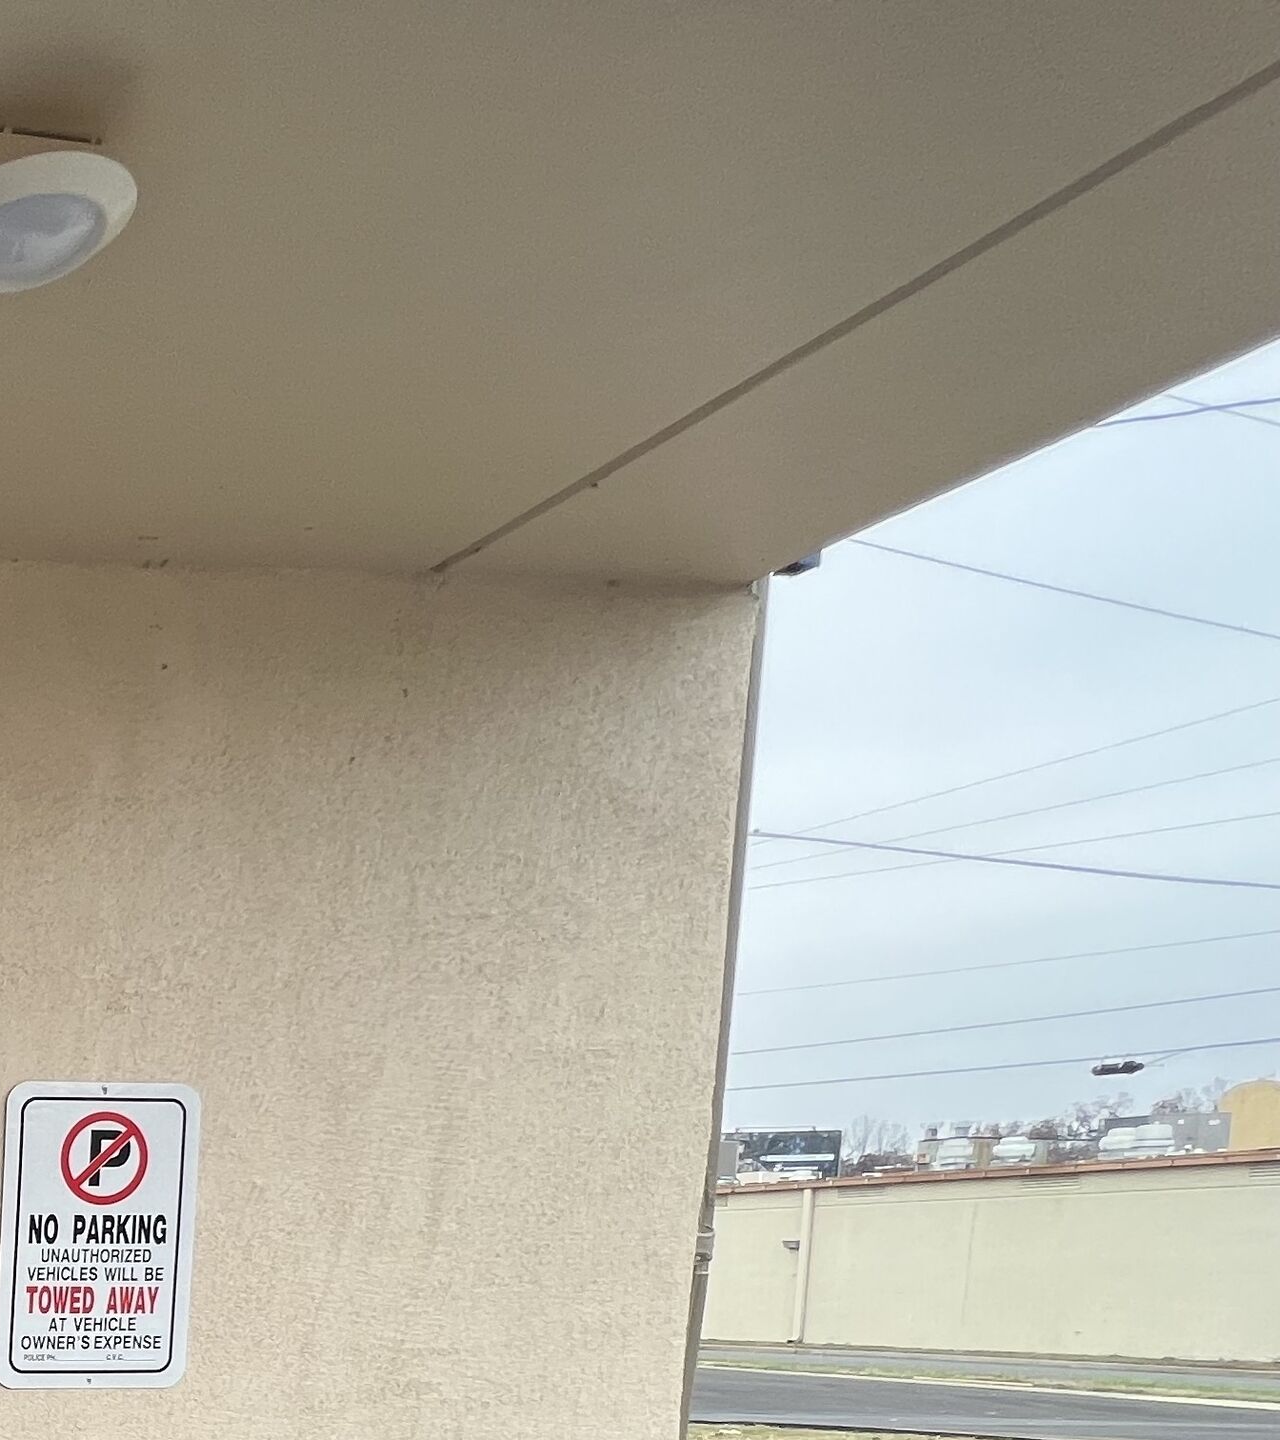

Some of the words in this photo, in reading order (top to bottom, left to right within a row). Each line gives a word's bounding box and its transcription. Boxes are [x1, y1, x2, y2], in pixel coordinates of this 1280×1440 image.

[28, 1214, 59, 1244] NO
[72, 1214, 167, 1244] PARKING
[40, 1248, 152, 1263] UNAUTHORIZED
[27, 1267, 98, 1282] VEHICLES
[104, 1267, 138, 1281] WILL
[145, 1267, 164, 1282] BE
[26, 1286, 95, 1314] TOWED
[106, 1286, 160, 1314] AWAY
[48, 1318, 66, 1332] AT
[73, 1317, 137, 1332] VEHICLE
[21, 1336, 90, 1350] OWNER'S
[94, 1335, 162, 1350] EXPENSE
